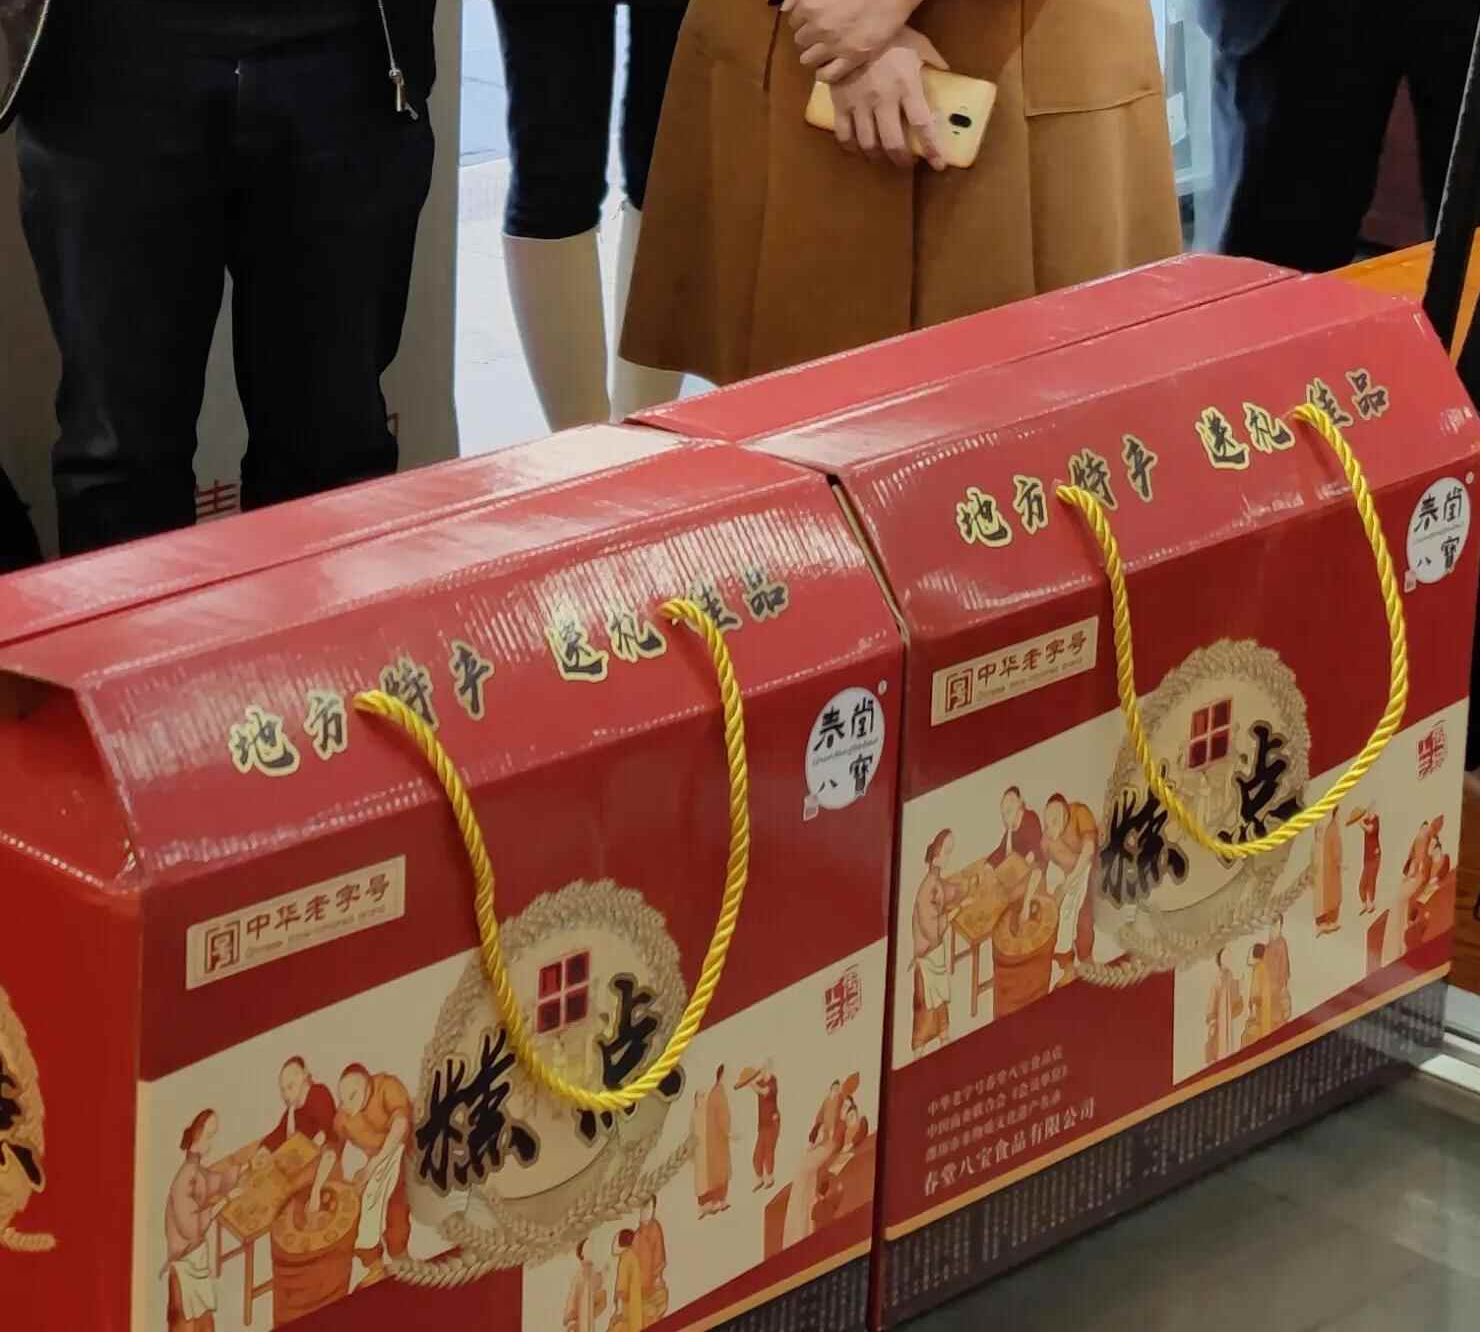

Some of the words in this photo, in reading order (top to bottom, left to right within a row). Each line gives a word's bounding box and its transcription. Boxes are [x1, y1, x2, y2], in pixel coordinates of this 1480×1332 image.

[977, 631, 1088, 686] 中华老字号
[246, 873, 390, 941] 中华老字号
